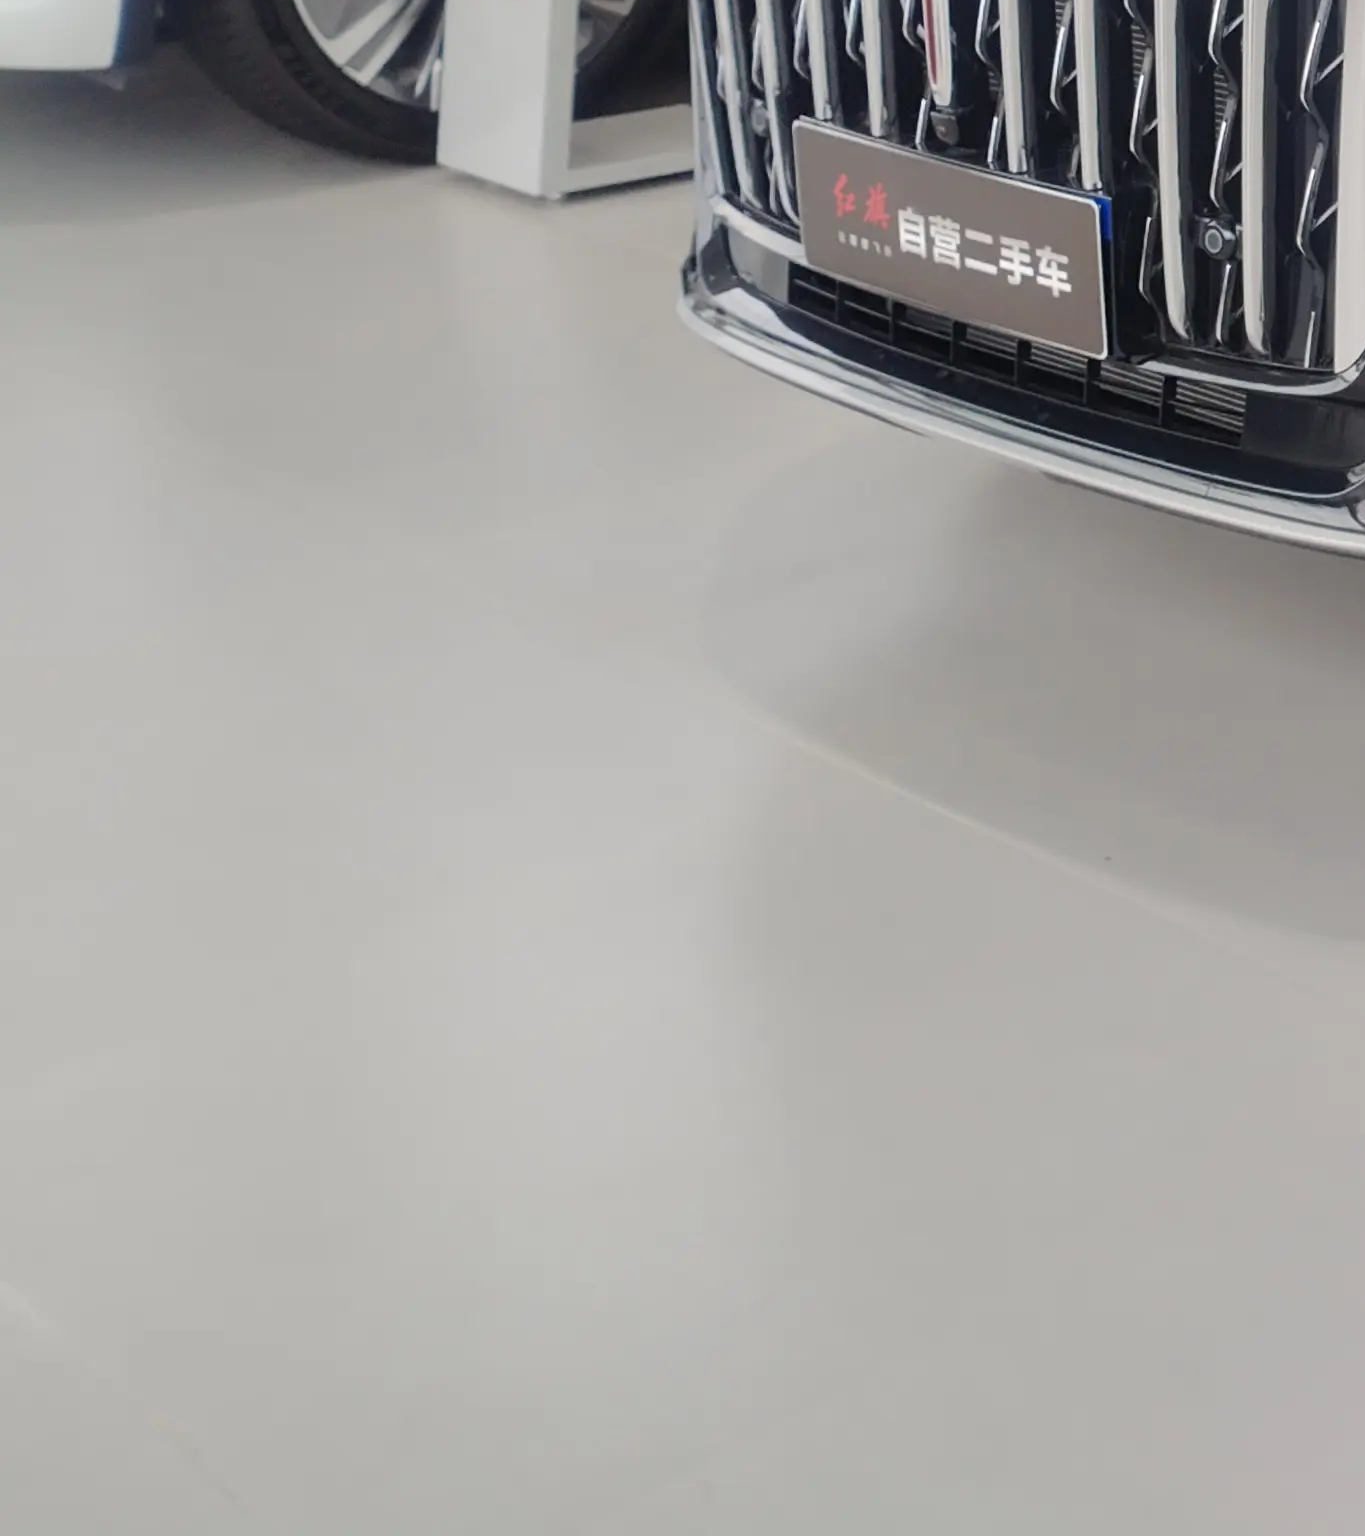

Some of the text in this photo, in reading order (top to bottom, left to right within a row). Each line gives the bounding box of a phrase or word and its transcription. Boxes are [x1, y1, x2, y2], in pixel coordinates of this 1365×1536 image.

[832, 172, 892, 230] 红旗
[897, 205, 1073, 299] 自营二手车
